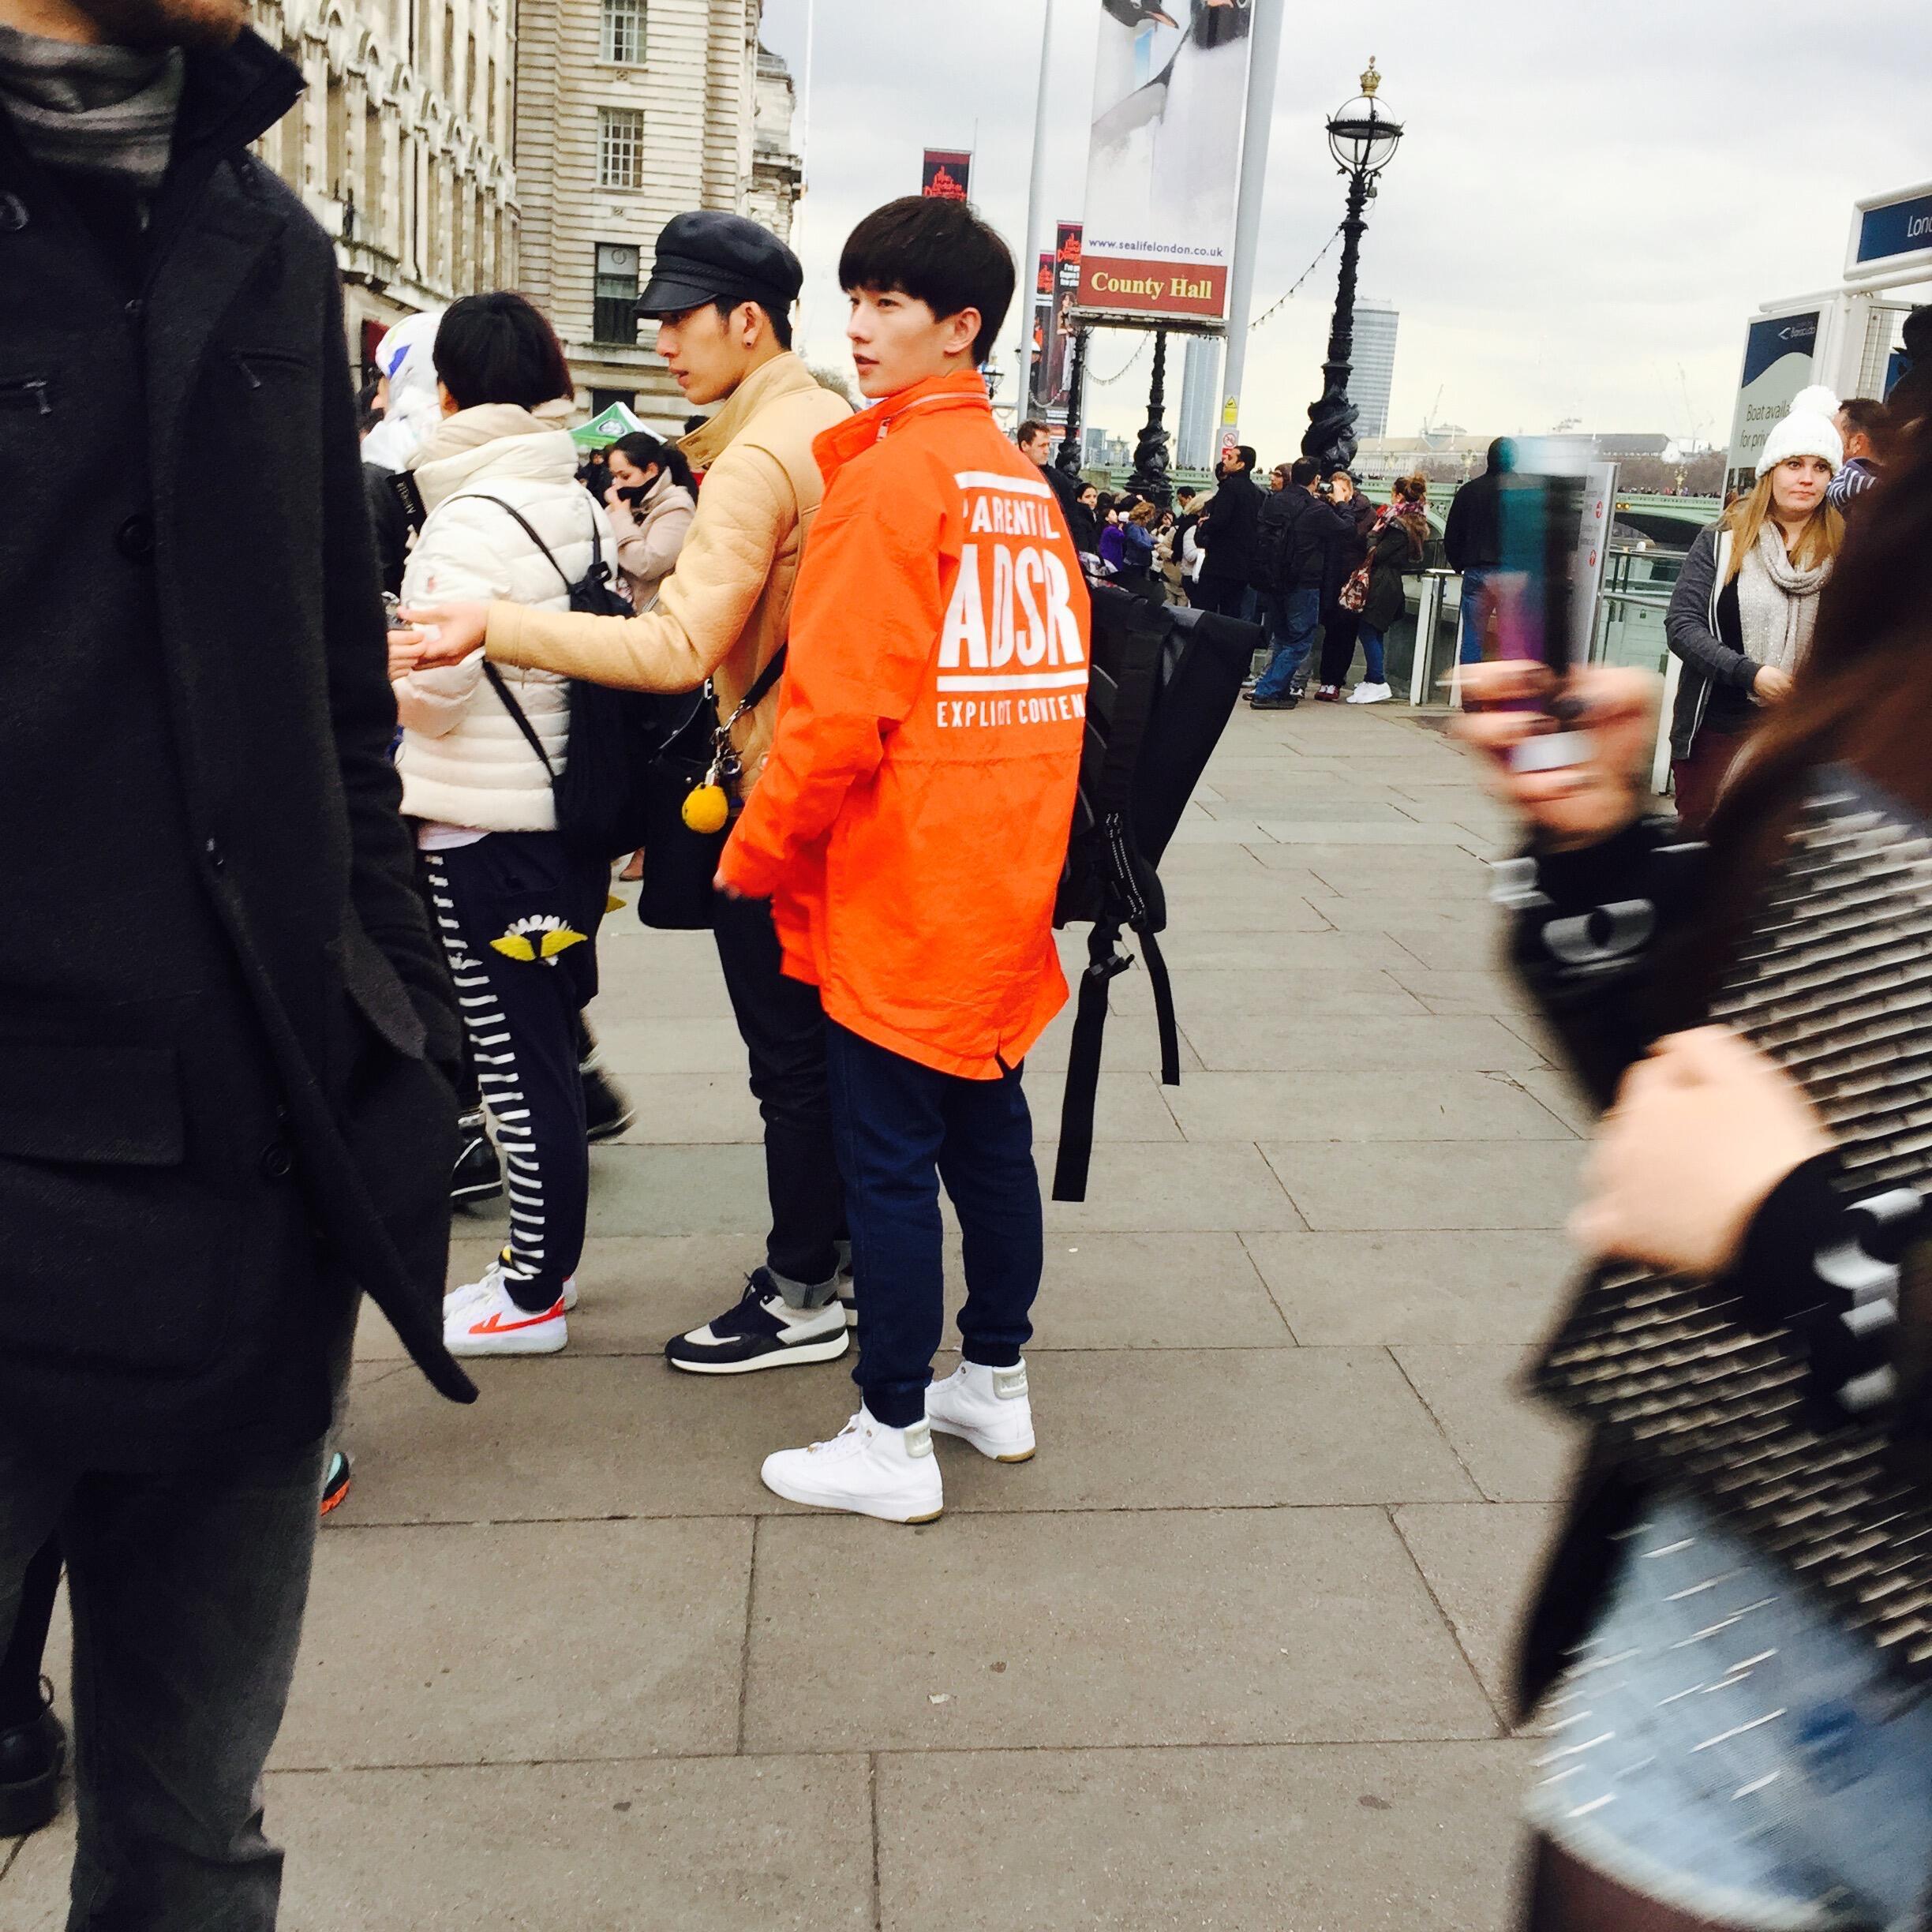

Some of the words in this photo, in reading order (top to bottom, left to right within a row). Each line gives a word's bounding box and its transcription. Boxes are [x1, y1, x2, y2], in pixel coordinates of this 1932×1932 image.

[1089, 238, 1222, 257] www.sealifelondon.co.uk
[1091, 271, 1164, 301] County
[1170, 277, 1211, 299] Hall
[1747, 403, 1765, 421] Boat
[1765, 399, 1790, 420] availa
[1739, 429, 1750, 448] for
[1750, 429, 1769, 451] priv
[938, 543, 1084, 668] ADSR
[1018, 693, 1086, 724] CONTEN
